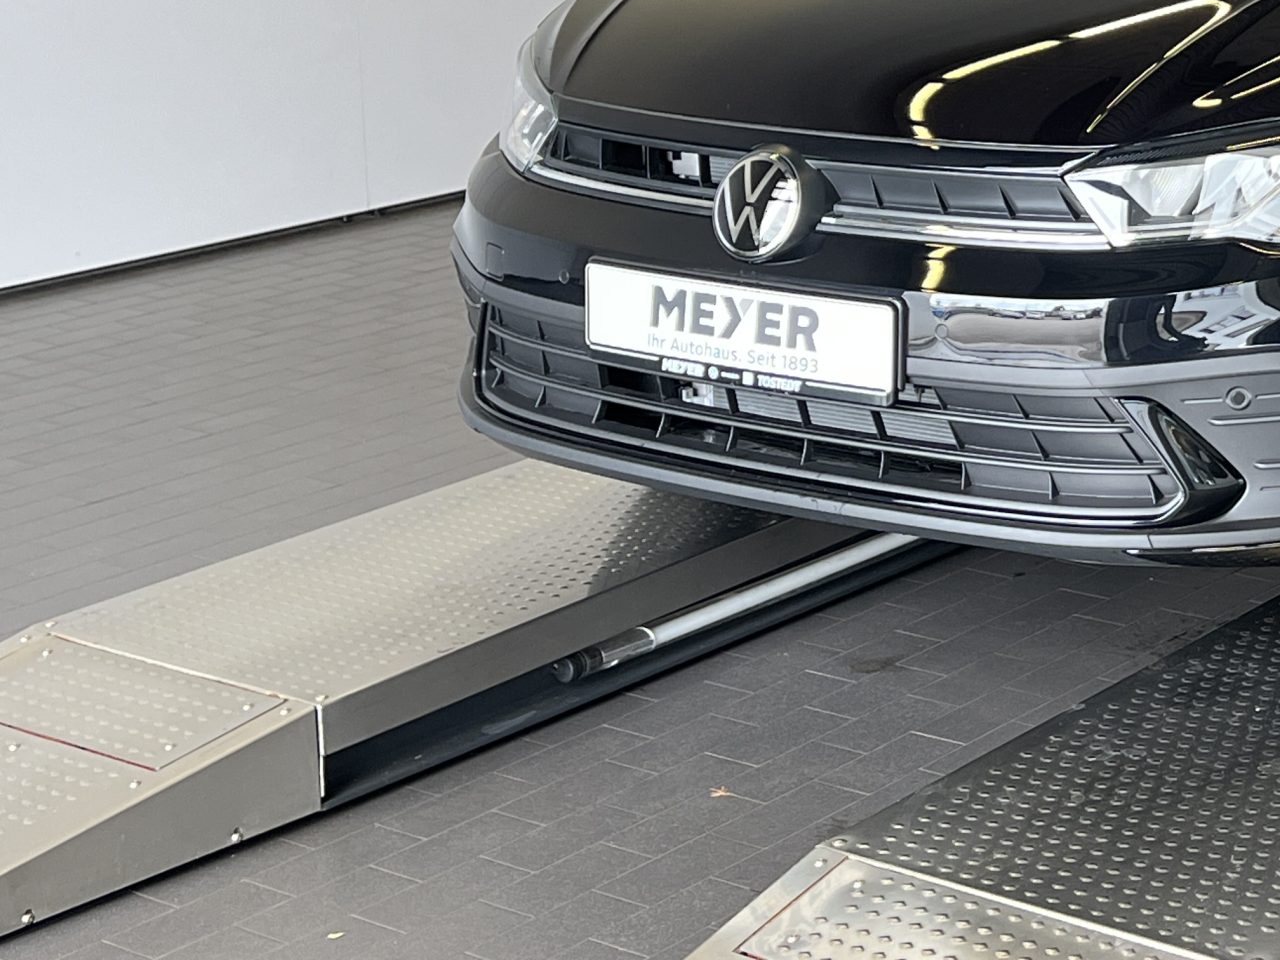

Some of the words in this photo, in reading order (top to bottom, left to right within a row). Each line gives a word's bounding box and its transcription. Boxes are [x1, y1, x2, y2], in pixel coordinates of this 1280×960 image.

[650, 285, 820, 352] MEYER
[647, 333, 665, 349] Ihr
[670, 339, 742, 363] Autohaus.
[747, 349, 776, 368] Seit
[781, 355, 819, 374] 1893
